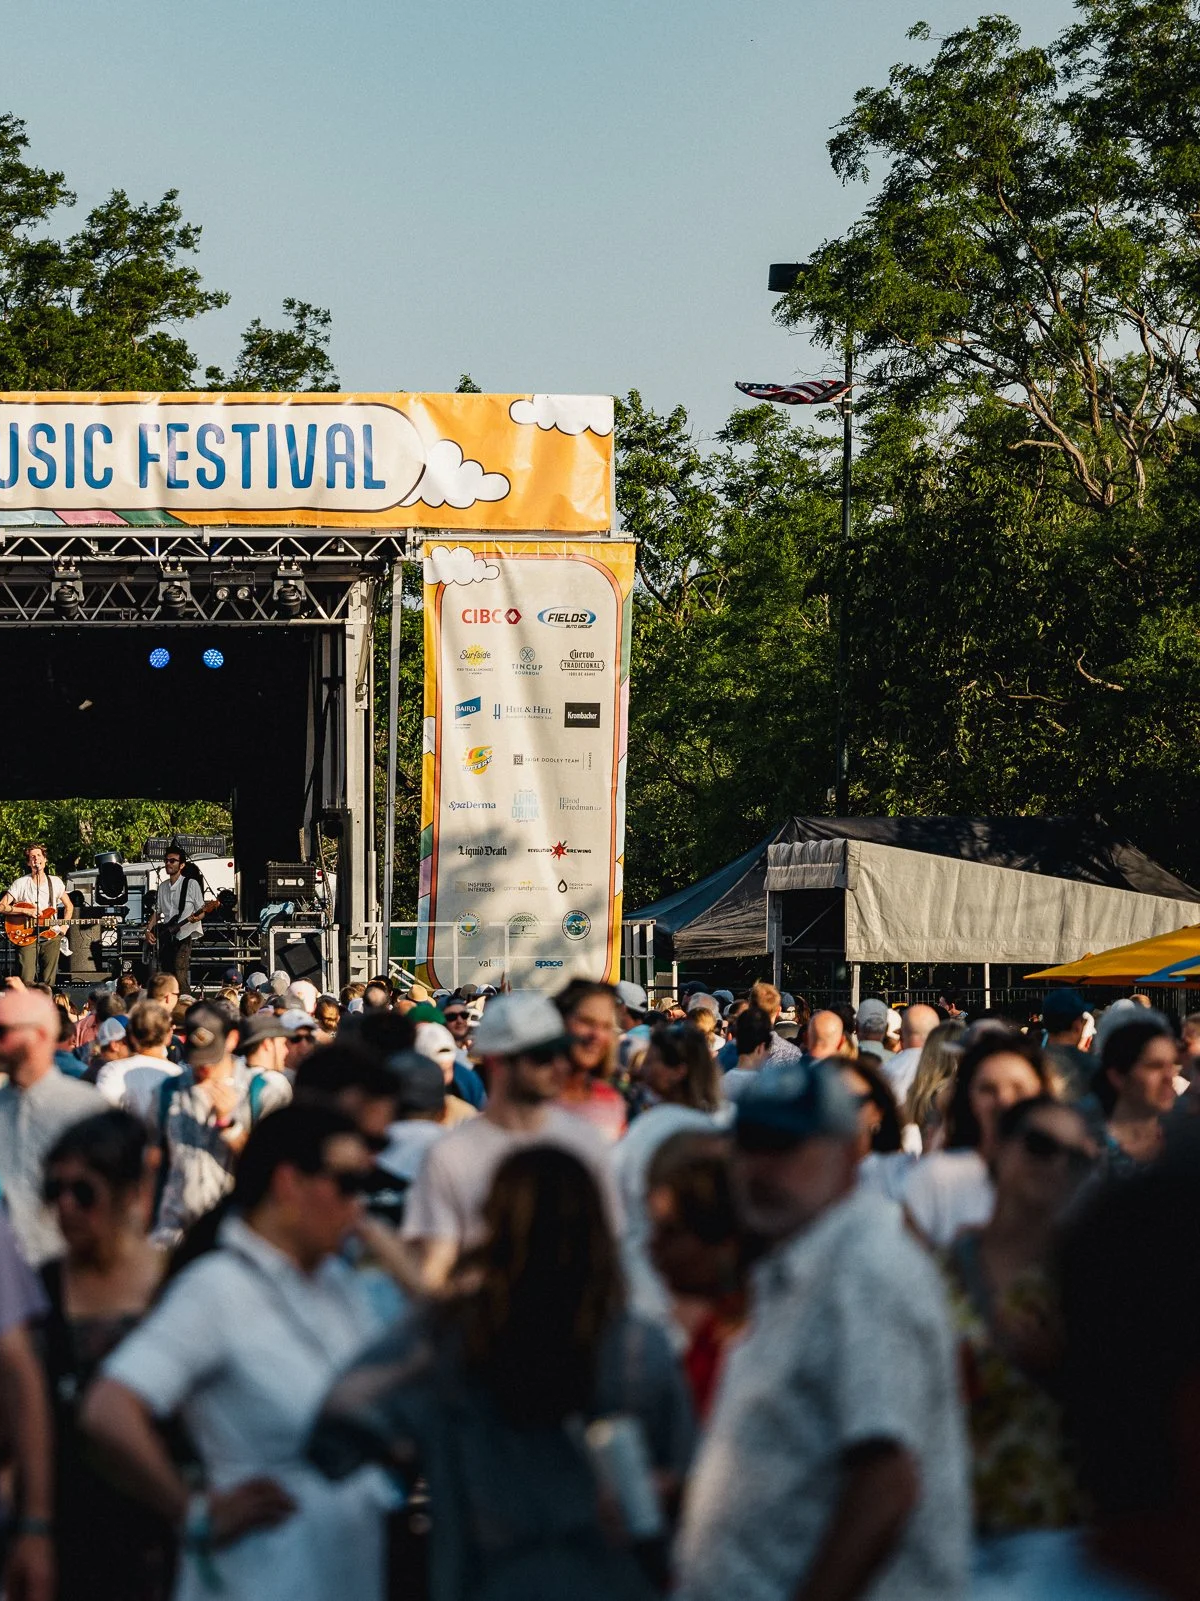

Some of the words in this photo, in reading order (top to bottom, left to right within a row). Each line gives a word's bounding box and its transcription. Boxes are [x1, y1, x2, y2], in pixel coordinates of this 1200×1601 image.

[139, 421, 386, 489] FESTIVAL
[461, 608, 503, 624] CIBC
[547, 613, 588, 623] FIELDS
[459, 649, 492, 660] Surfside
[569, 649, 595, 660] Cuervo
[511, 663, 543, 671] TINCUP
[524, 705, 532, 713] &
[567, 711, 598, 720] Krombacher
[448, 800, 497, 811] SpaDerma
[562, 803, 594, 811] Friedman
[457, 845, 484, 858] Liquid
[484, 846, 508, 856] Death
[534, 960, 564, 969] space
